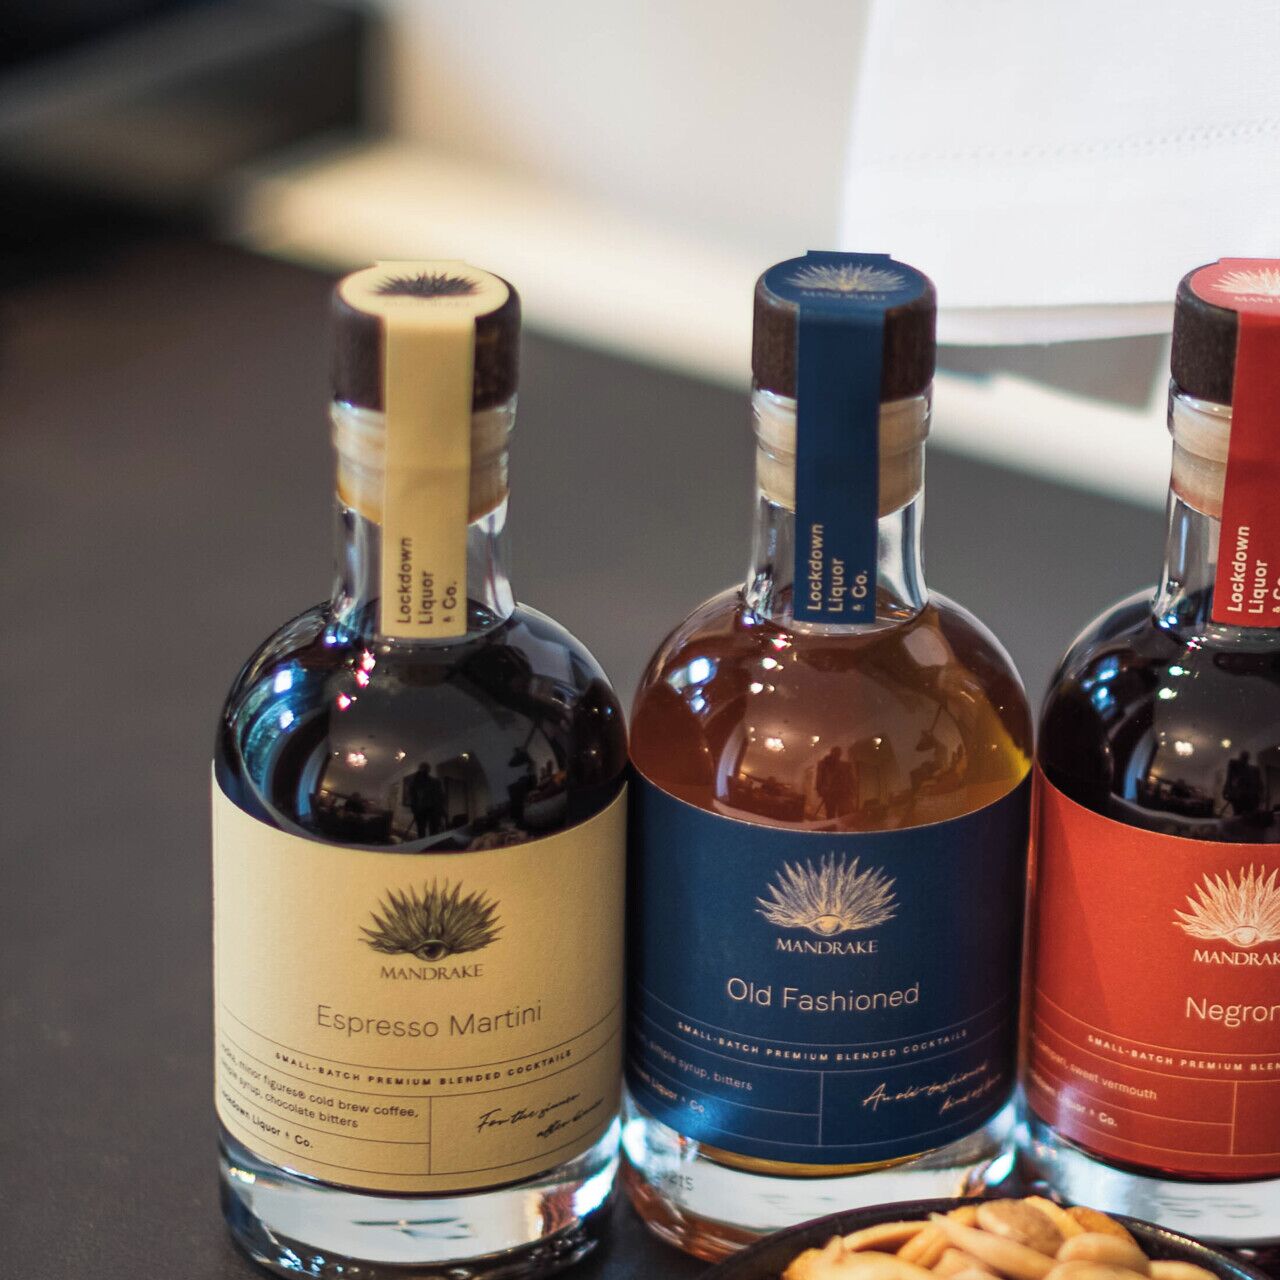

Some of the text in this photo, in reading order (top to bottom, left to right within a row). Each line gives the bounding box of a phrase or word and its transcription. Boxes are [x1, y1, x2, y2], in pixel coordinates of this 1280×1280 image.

[397, 537, 412, 624] Lockdown
[807, 523, 824, 611] Lockdown
[828, 558, 847, 612] Liquor
[852, 570, 868, 598] Co.
[1227, 526, 1250, 612] Lockdown
[418, 570, 437, 625] Liquor
[442, 581, 458, 610] Co.
[1248, 560, 1269, 614] Liquor
[775, 937, 879, 955] MANDRAKE
[380, 963, 485, 981] MANDRAKE
[726, 976, 921, 1013] Old Fashioned
[316, 1000, 543, 1038] Espresso Martini
[677, 1020, 968, 1062] SMALL-BATCH PREMIUM BLENDED COCKTAILS
[1087, 1034, 1174, 1066] SMALL-BATCH
[1180, 1059, 1243, 1071] PREMIUM
[274, 1048, 573, 1086] SMALL-BATCH PREMIUM BLENDED COCKTAILS
[713, 1071, 753, 1092] bitters
[309, 1093, 334, 1107] cold
[338, 1099, 369, 1114] brew
[373, 1103, 420, 1118] coffee,
[1101, 1078, 1157, 1101] vermouth
[265, 1093, 316, 1119] chocolate
[319, 1112, 359, 1129] bitters
[1098, 1111, 1119, 1127] Co.
[252, 1114, 281, 1136] Liquor
[294, 1133, 314, 1149] Co.
